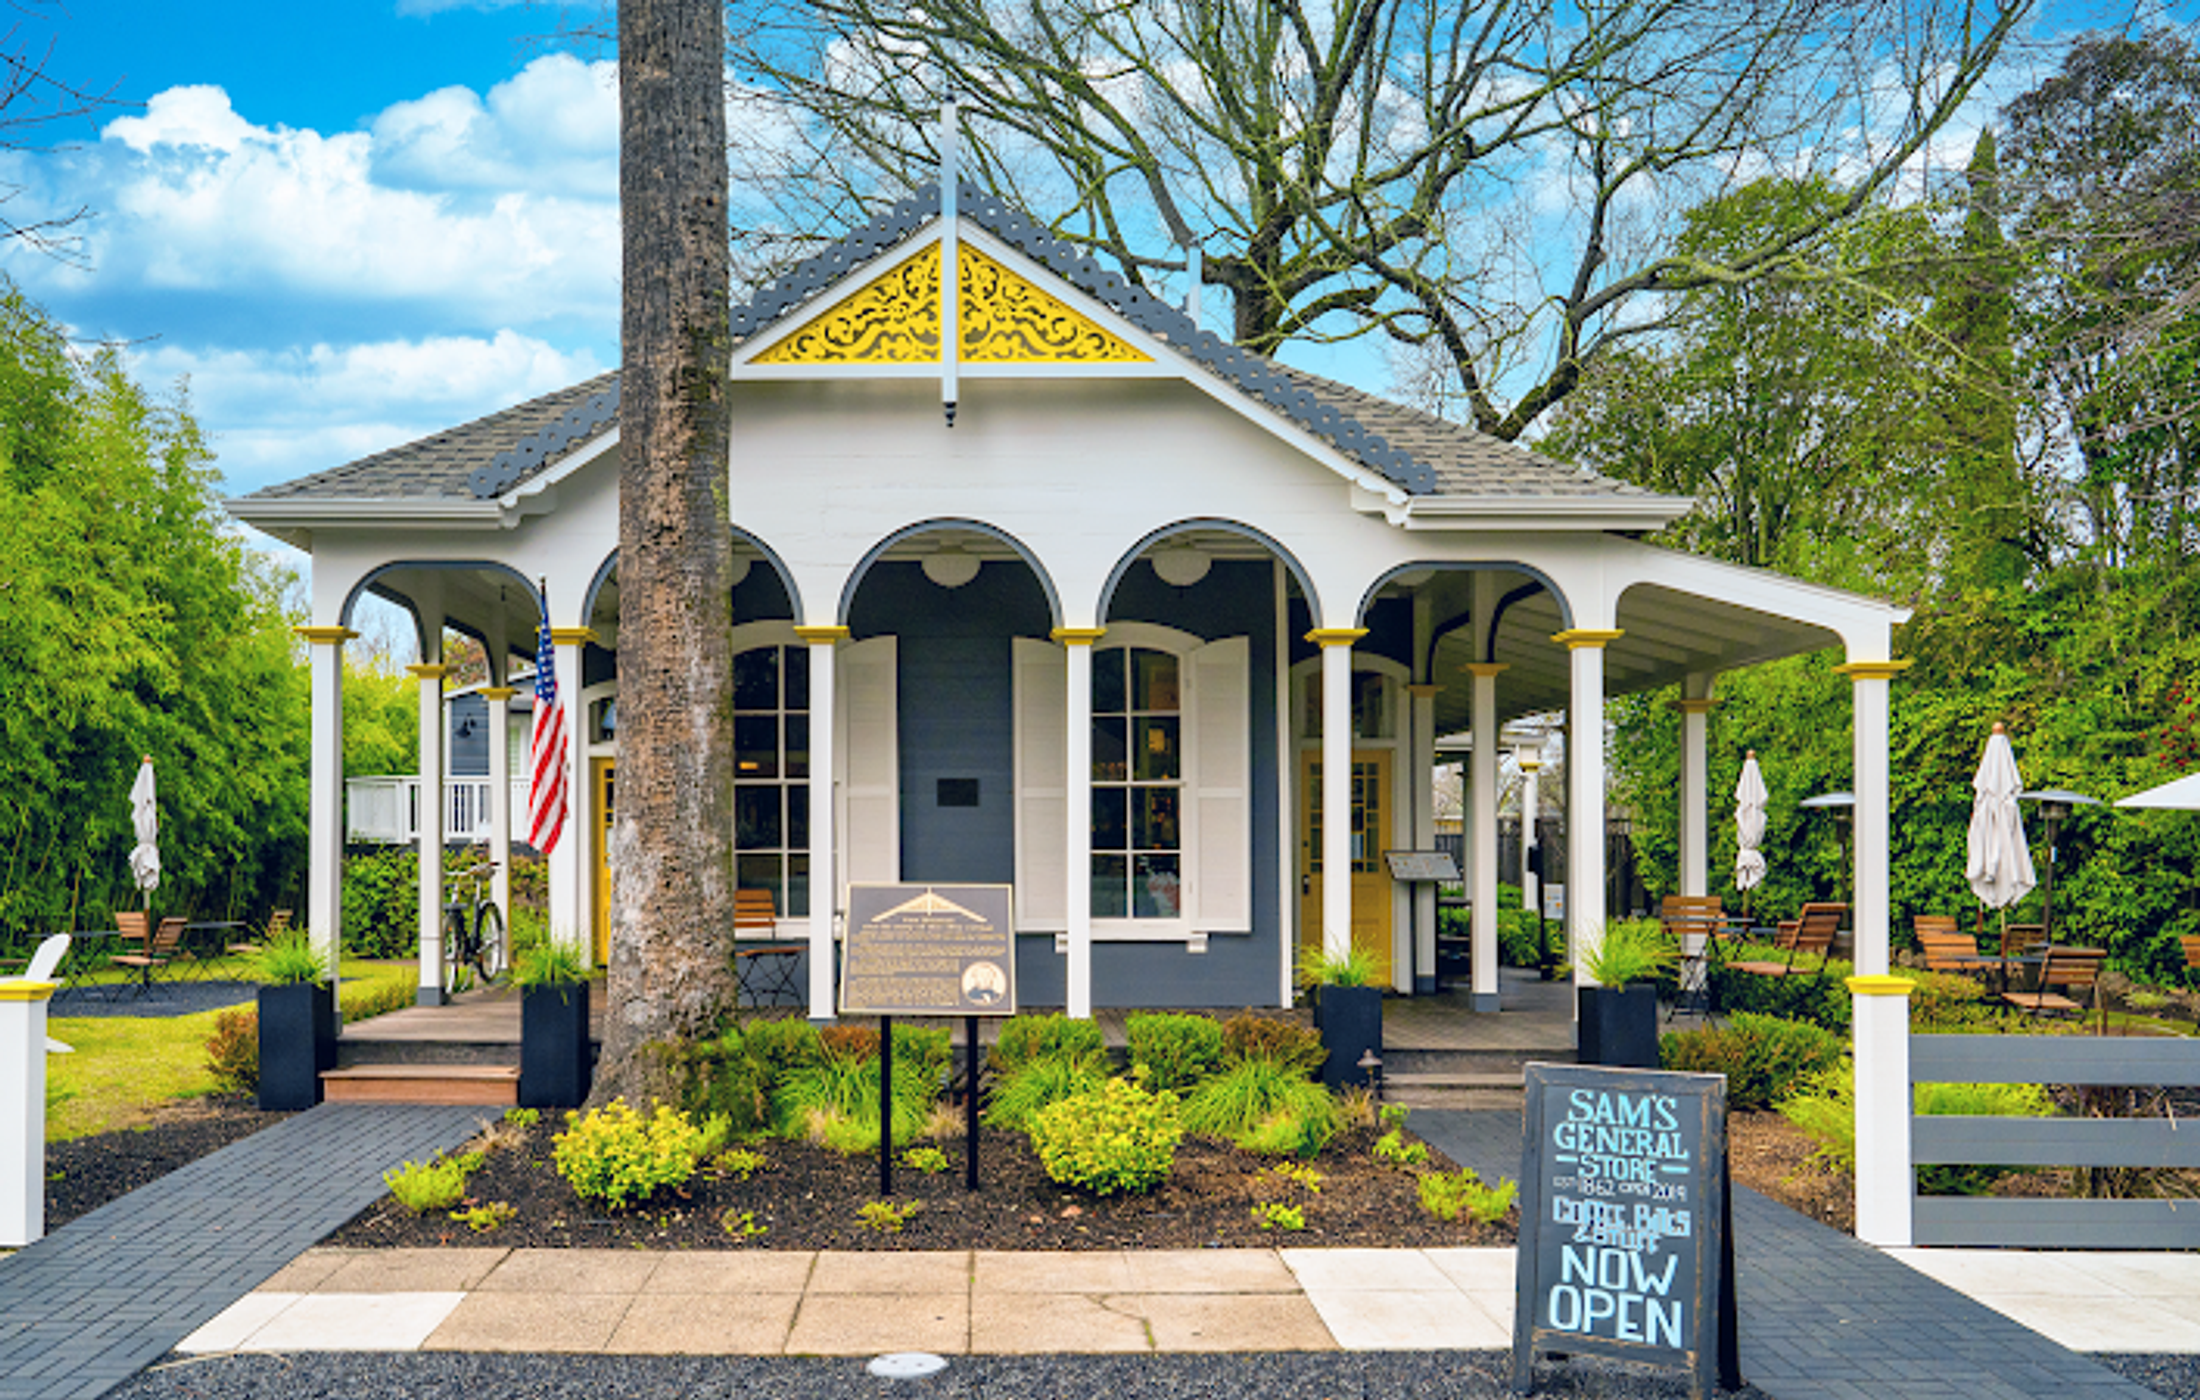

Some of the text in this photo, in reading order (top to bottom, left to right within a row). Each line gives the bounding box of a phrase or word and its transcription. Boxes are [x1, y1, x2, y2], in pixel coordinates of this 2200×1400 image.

[1567, 1089, 1679, 1131] SAM'S
[1553, 1121, 1690, 1159] GENERAL
[1577, 1154, 1657, 1183] STORE
[1578, 1178, 1616, 1197] 1862
[1652, 1183, 1688, 1202] 2019
[1571, 1226, 1591, 1243] &
[1562, 1244, 1679, 1296] NOW
[1549, 1283, 1682, 1349] OPEN
